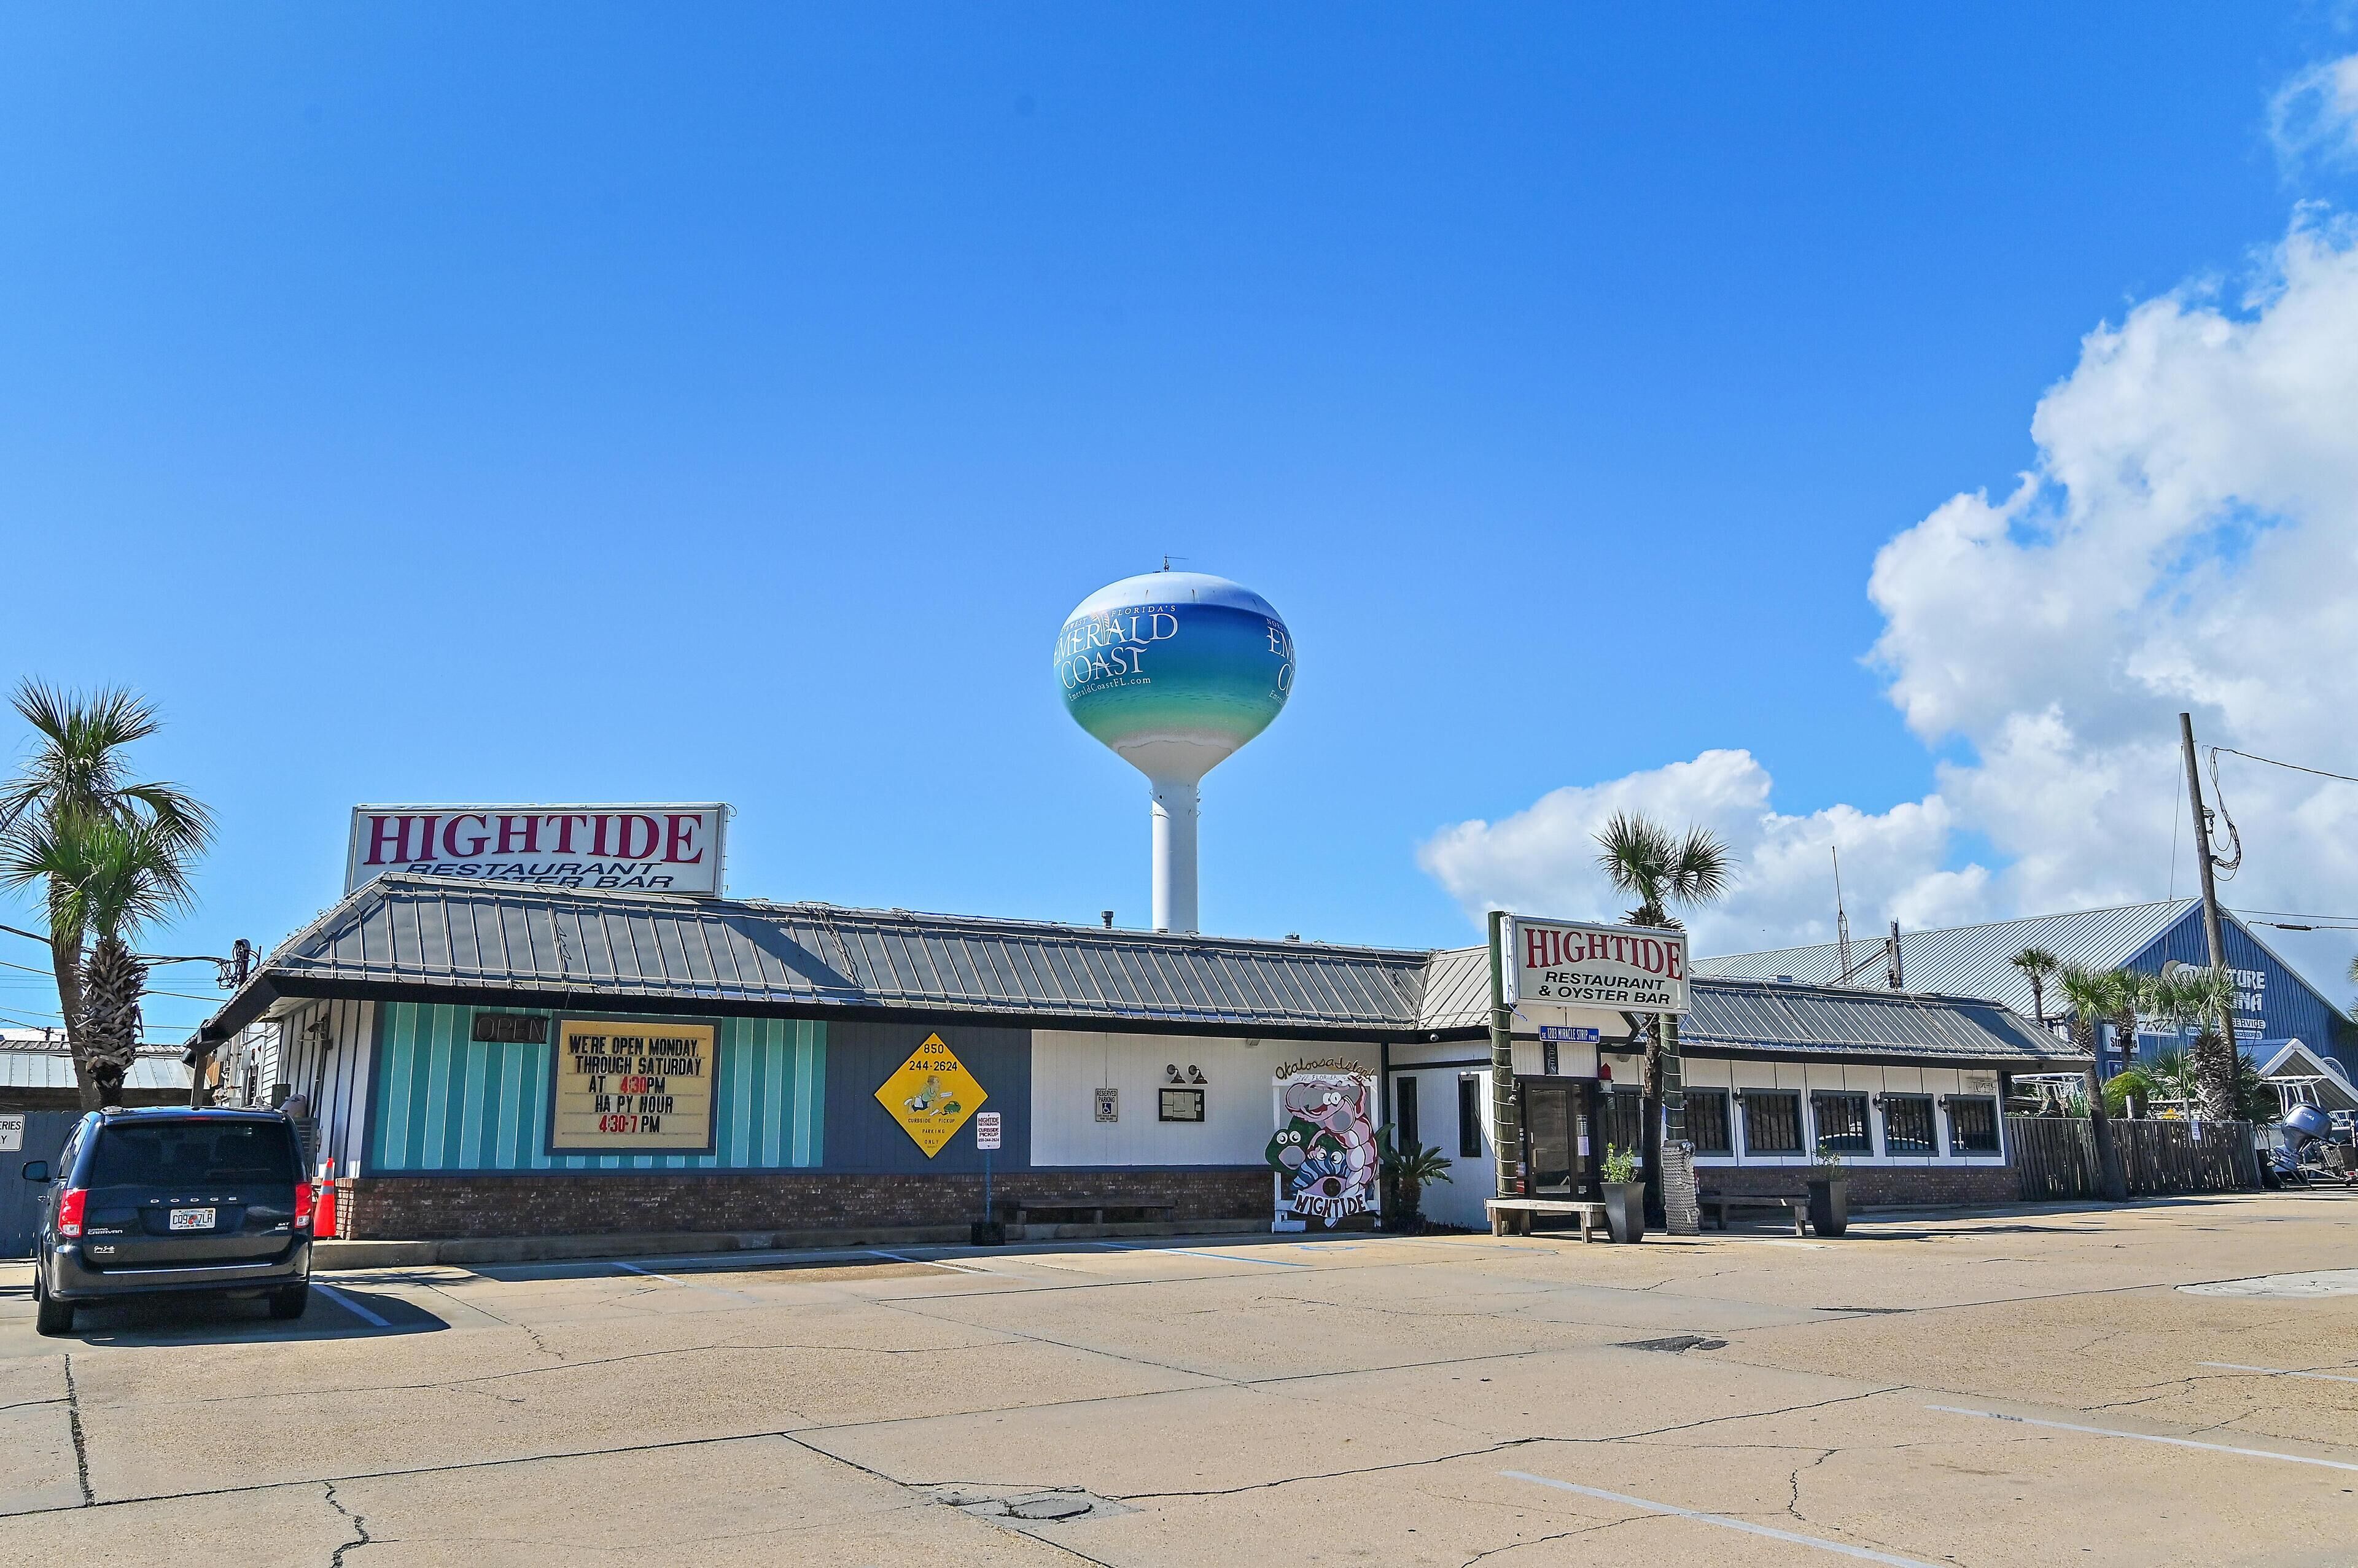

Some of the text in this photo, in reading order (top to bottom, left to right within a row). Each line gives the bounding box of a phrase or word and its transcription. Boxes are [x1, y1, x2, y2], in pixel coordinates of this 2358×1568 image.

[1111, 605, 1176, 617] FLORIDA'S
[1054, 613, 1179, 668] EMERALD
[1061, 646, 1148, 689] COAST
[1068, 677, 1152, 702] EmeraldCoastFL.com
[363, 813, 704, 865] HIGHTIDE
[408, 863, 662, 875] RESTAURANT
[593, 875, 674, 888] BAR
[1524, 928, 1683, 981] HIGHTIDE
[1545, 971, 1665, 990] RESTAURANT
[1538, 985, 1670, 1004] & OYSTER BAR
[477, 1017, 547, 1041] OPEN
[1547, 1028, 1557, 1039] 1203
[1558, 1028, 1576, 1040] MIRACLE
[1576, 1029, 1588, 1041] STRIP
[569, 1035, 605, 1054] WE'RE
[613, 1037, 644, 1055] OPEN
[924, 1044, 944, 1054] 850
[2110, 1036, 2137, 1049] Stoge
[575, 1055, 702, 1076] THROUGH SATURDAY
[909, 1061, 957, 1071] 244-2624
[1275, 1057, 1334, 1081] Okaloosa
[588, 1075, 606, 1093] AT
[639, 1096, 673, 1113] HOUR
[641, 1116, 660, 1133] PM
[1294, 1193, 1366, 1217] HIGHTIDE
